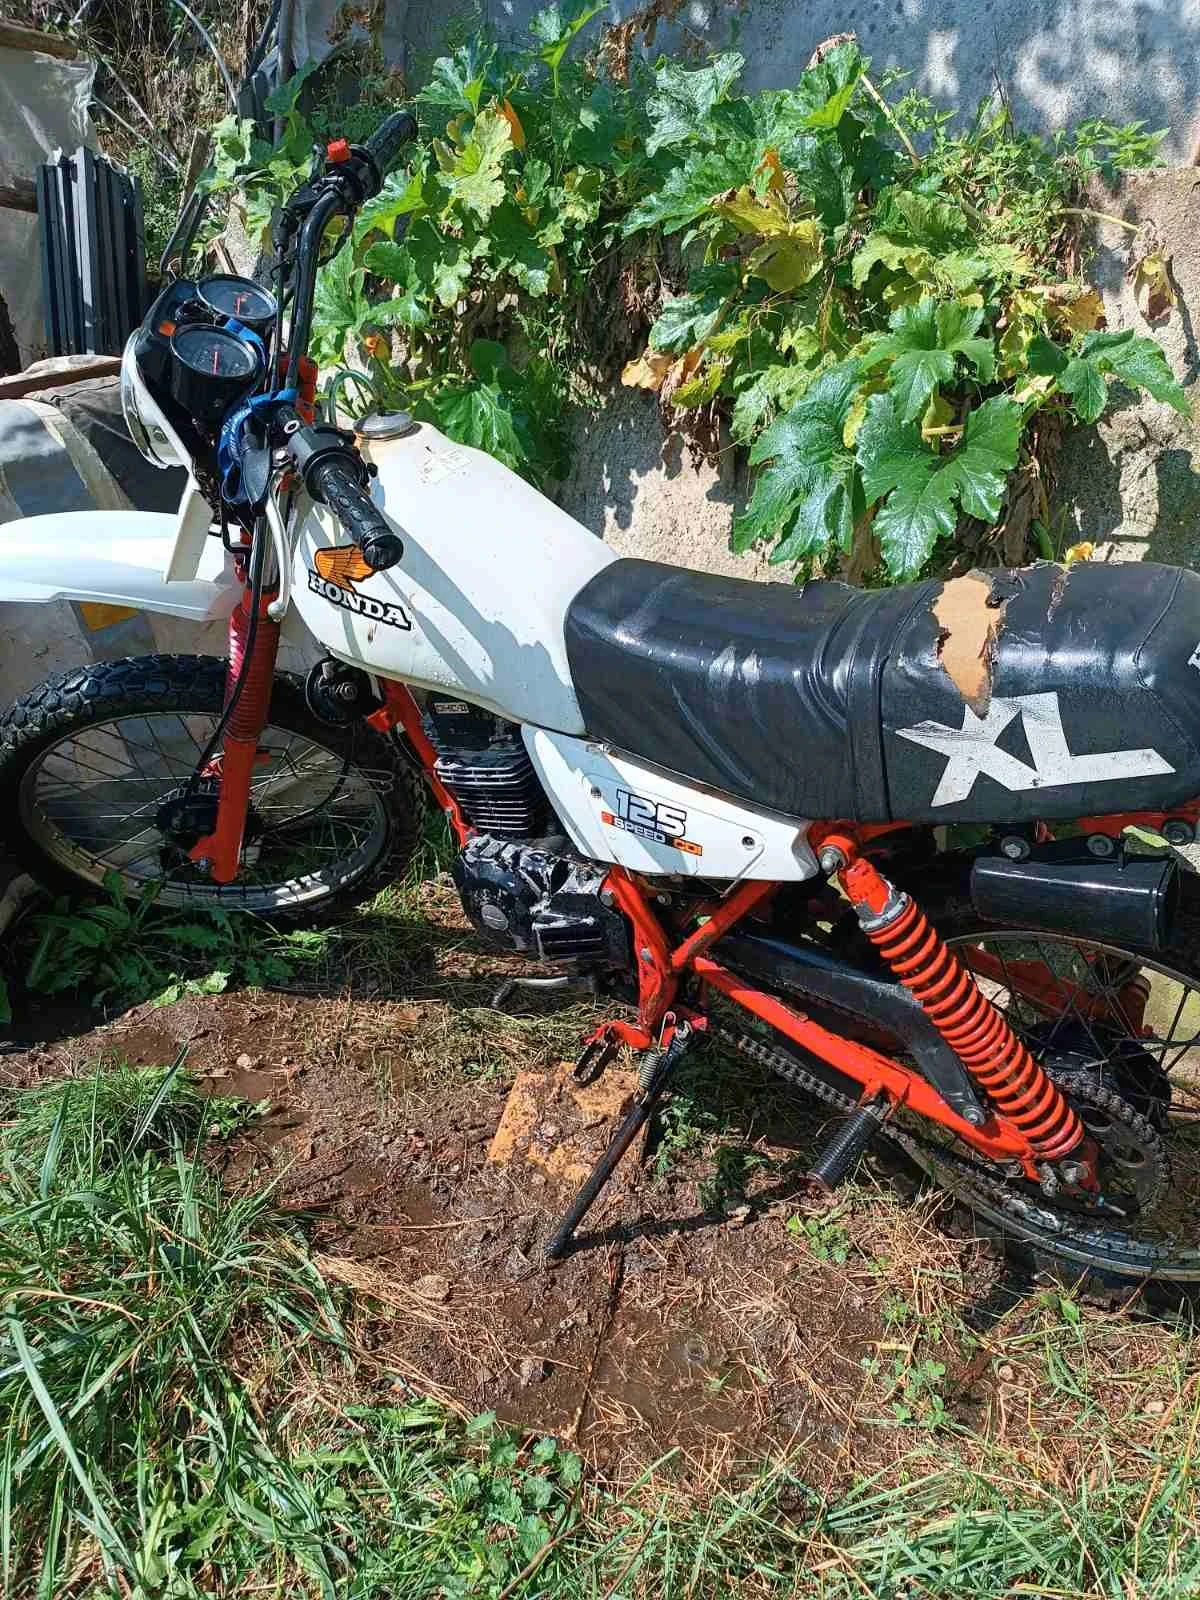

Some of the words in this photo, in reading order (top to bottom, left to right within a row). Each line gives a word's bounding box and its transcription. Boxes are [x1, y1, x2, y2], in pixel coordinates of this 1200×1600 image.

[308, 568, 412, 631] HONDA
[895, 691, 1177, 807] XL
[613, 817, 667, 844] SPEED
[616, 788, 688, 838] 125
